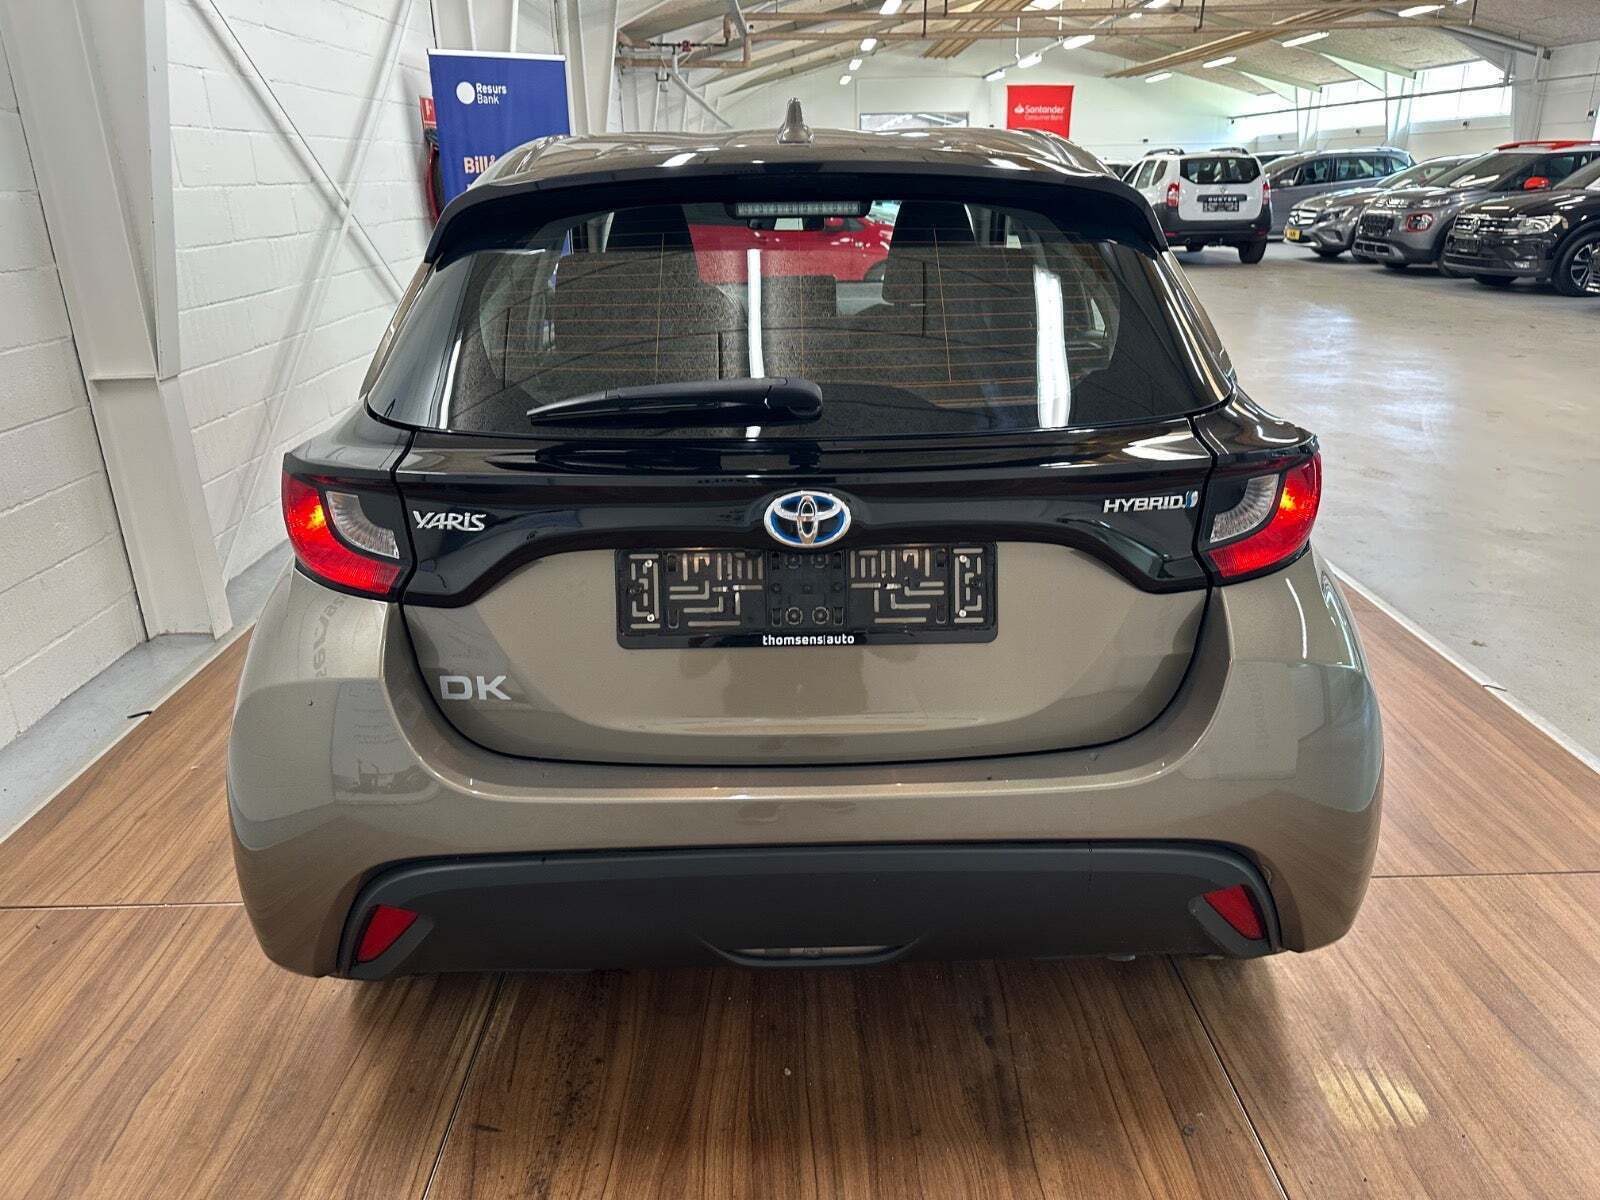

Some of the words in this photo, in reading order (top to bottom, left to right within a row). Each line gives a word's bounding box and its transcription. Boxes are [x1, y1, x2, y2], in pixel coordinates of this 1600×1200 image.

[475, 83, 507, 94] Resurs
[477, 94, 499, 104] Bank
[1025, 104, 1064, 113] Santander
[1103, 495, 1185, 513] HYBRID
[439, 675, 512, 700] DK
